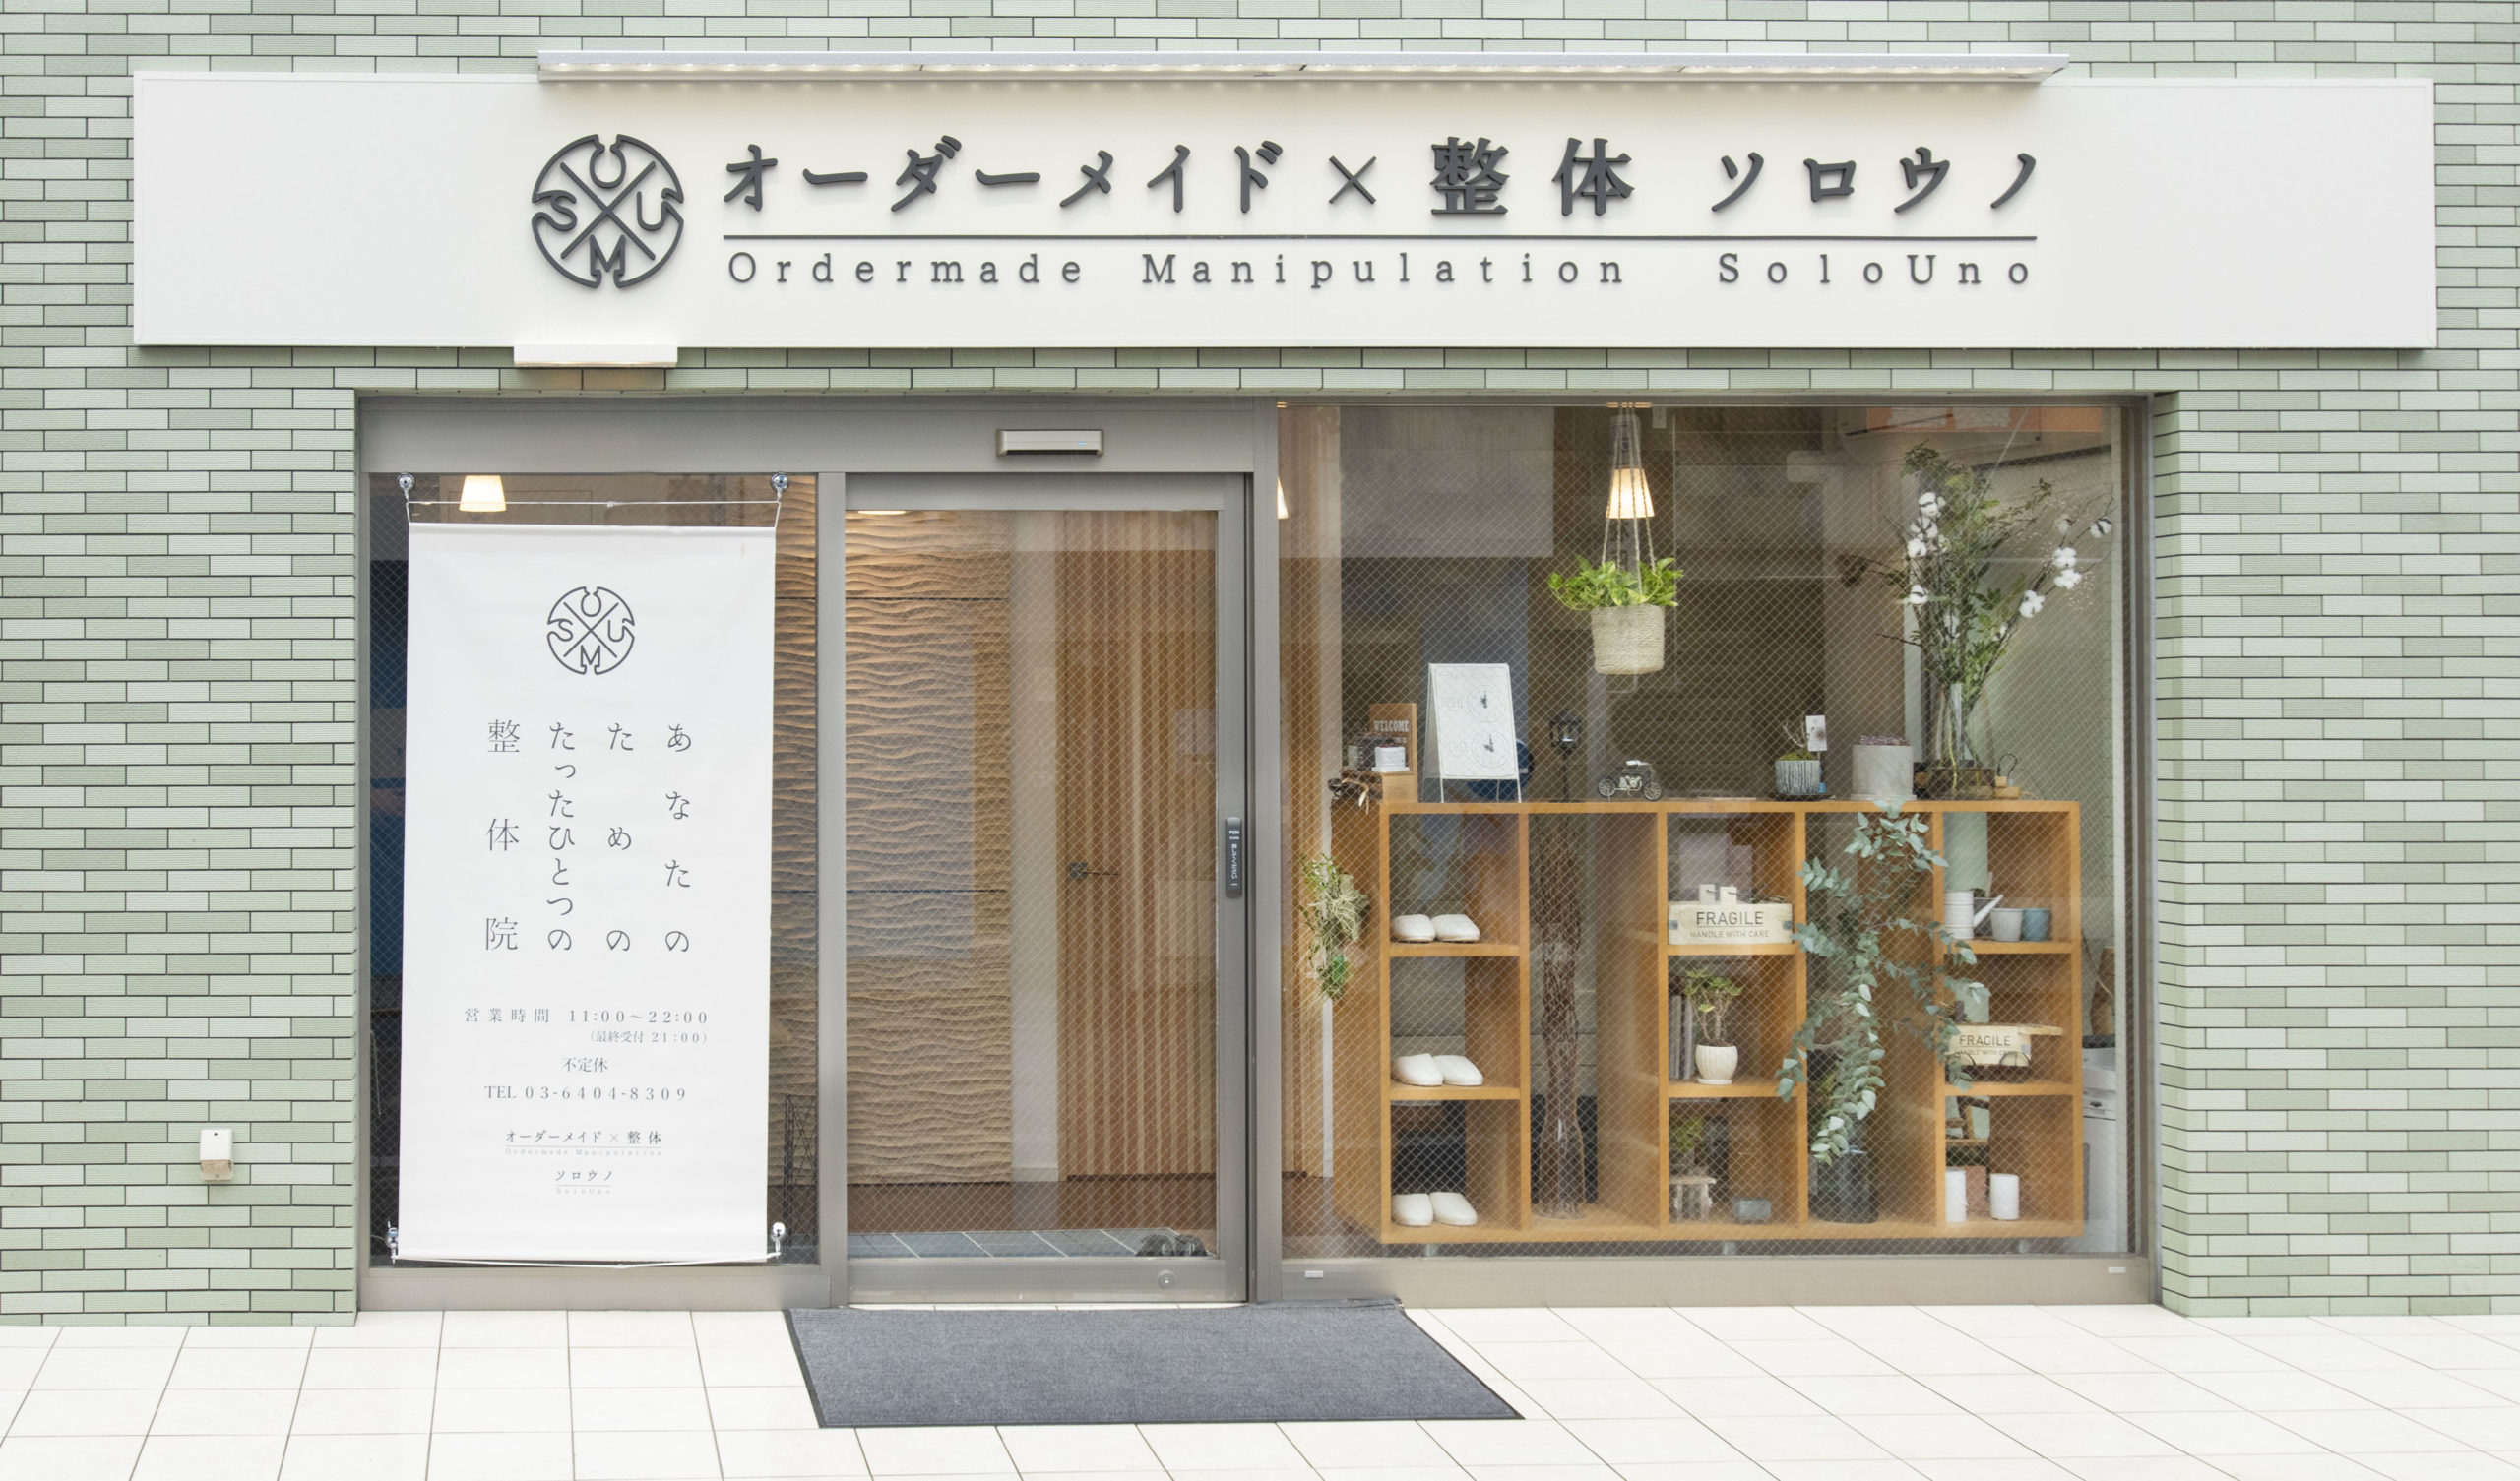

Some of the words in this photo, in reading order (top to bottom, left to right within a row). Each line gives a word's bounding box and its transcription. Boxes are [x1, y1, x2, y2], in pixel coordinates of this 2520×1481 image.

[1712, 147, 2037, 214] ソロウノ
[728, 252, 1082, 284] Ordermade
[1142, 253, 1623, 290] Manipulation
[1718, 252, 2030, 286] SoloUno
[1374, 720, 1410, 732] WELCOME
[485, 718, 521, 952] 整体院
[546, 721, 577, 952] たったひとつの
[605, 722, 635, 952] ための
[664, 722, 692, 953] あなたの
[1696, 911, 1764, 925] FRAGILE
[465, 1008, 549, 1023] 営業時間
[1960, 1035, 2011, 1046] FRAGILE
[564, 1057, 608, 1073] 不定休
[484, 1085, 517, 1099] TEL
[525, 1086, 686, 1101] 03-6404-8309
[555, 1169, 613, 1182] ソロウノ
